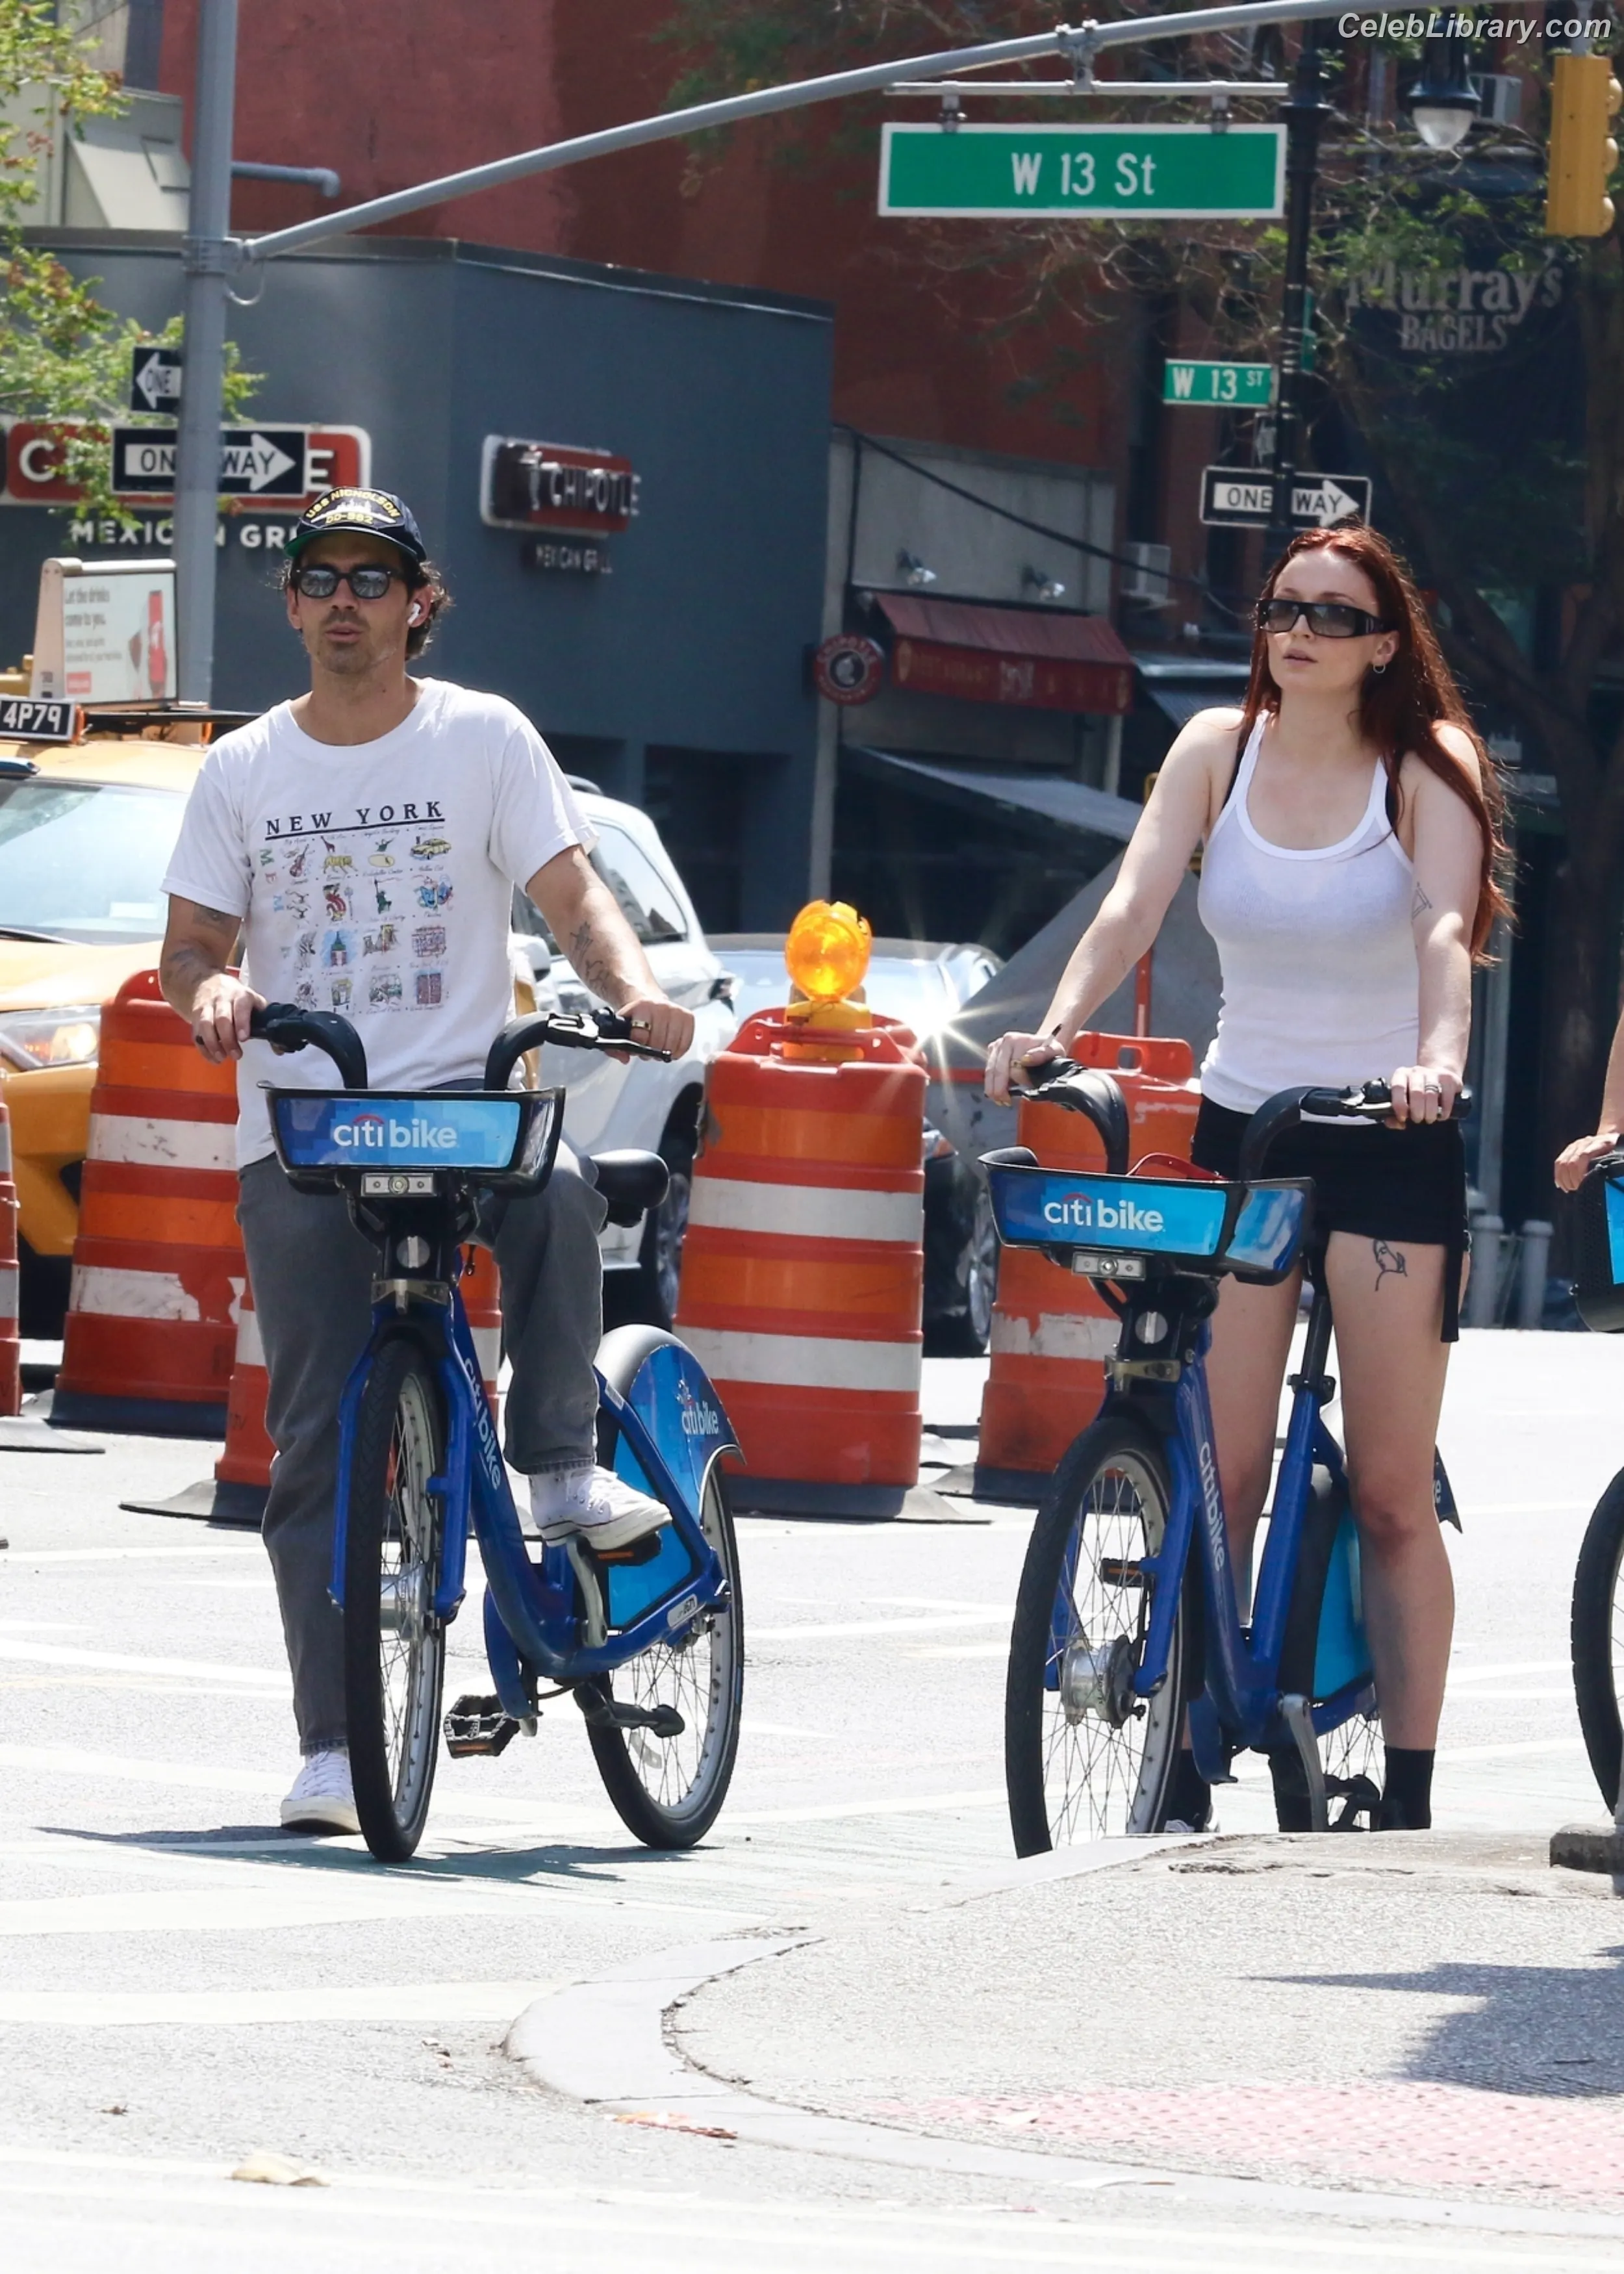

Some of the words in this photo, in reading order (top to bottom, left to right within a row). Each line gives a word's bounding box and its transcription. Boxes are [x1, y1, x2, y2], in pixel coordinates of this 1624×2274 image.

[1011, 153, 1043, 195] W
[1061, 153, 1096, 195] 13
[1115, 154, 1157, 195] St
[1400, 314, 1508, 352] BAGELS
[144, 368, 171, 394] ONE
[1173, 367, 1195, 399] W
[1211, 368, 1237, 400] 13
[1246, 371, 1264, 387] ST
[140, 448, 175, 472] ON
[222, 450, 275, 475] WAY
[305, 498, 330, 518] USS
[330, 489, 401, 518] NICHOLSON
[540, 461, 642, 515] CHIPOTLE
[1227, 487, 1273, 513] ONE
[1295, 492, 1343, 514] WAY
[70, 520, 225, 546] MEXICN
[3, 702, 62, 732] 4P79
[266, 812, 332, 836] NEW
[356, 801, 443, 824] YORK
[333, 1114, 384, 1147] citi
[390, 1119, 457, 1148] bike
[1043, 1192, 1092, 1227] citi
[1097, 1199, 1164, 1233] bike
[477, 1408, 501, 1491] bike
[1206, 1489, 1225, 1572] bike
